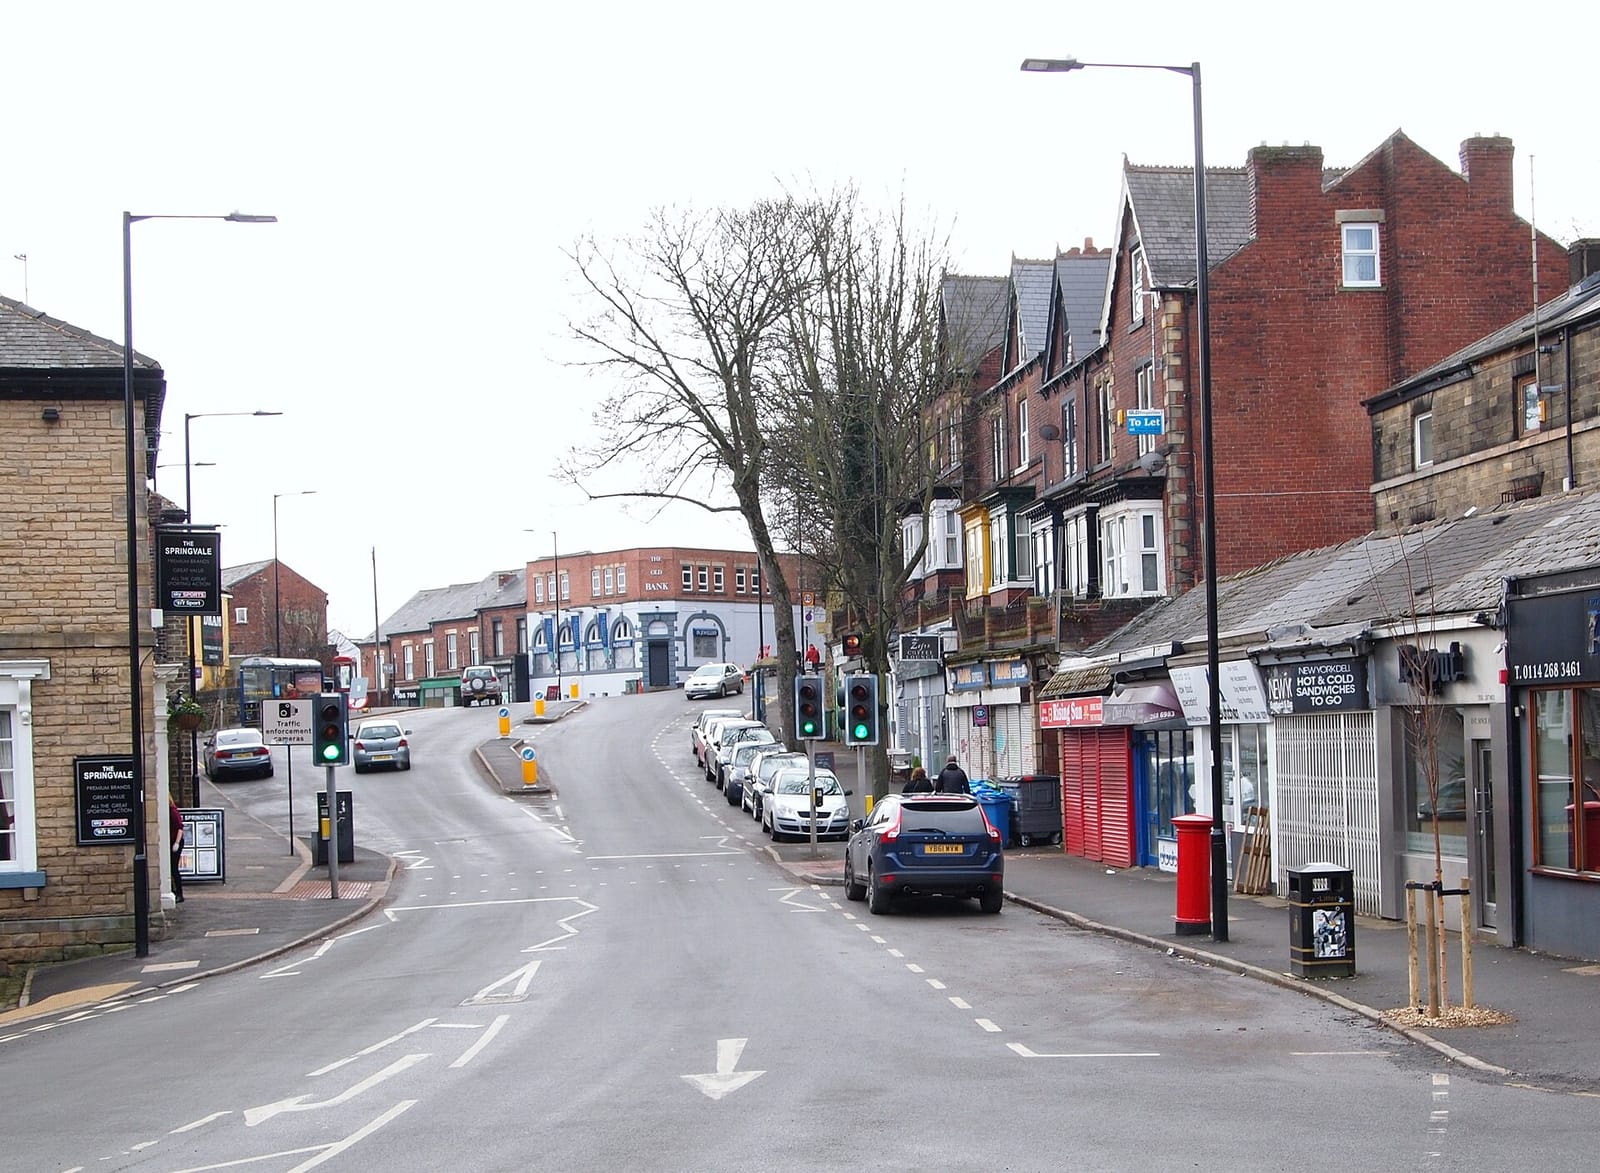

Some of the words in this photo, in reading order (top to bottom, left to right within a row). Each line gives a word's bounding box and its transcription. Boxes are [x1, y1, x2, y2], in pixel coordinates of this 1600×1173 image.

[1128, 417, 1141, 427] To
[1144, 417, 1160, 426] Let
[164, 547, 212, 555] SPRINGVALE
[645, 582, 669, 591] BANK
[1514, 665, 1522, 680] T.
[1523, 664, 1542, 679] 0114
[1544, 662, 1559, 678] 268
[1561, 661, 1580, 677] 3461
[1296, 676, 1316, 686] HOT
[1326, 674, 1354, 685] COLD
[1296, 684, 1356, 697] SANDWICHES
[1311, 697, 1323, 706] TO
[1325, 696, 1342, 705] GO
[1052, 702, 1070, 726] Rising
[1071, 701, 1082, 720] Sun
[84, 771, 134, 780] SPRINGVALE
